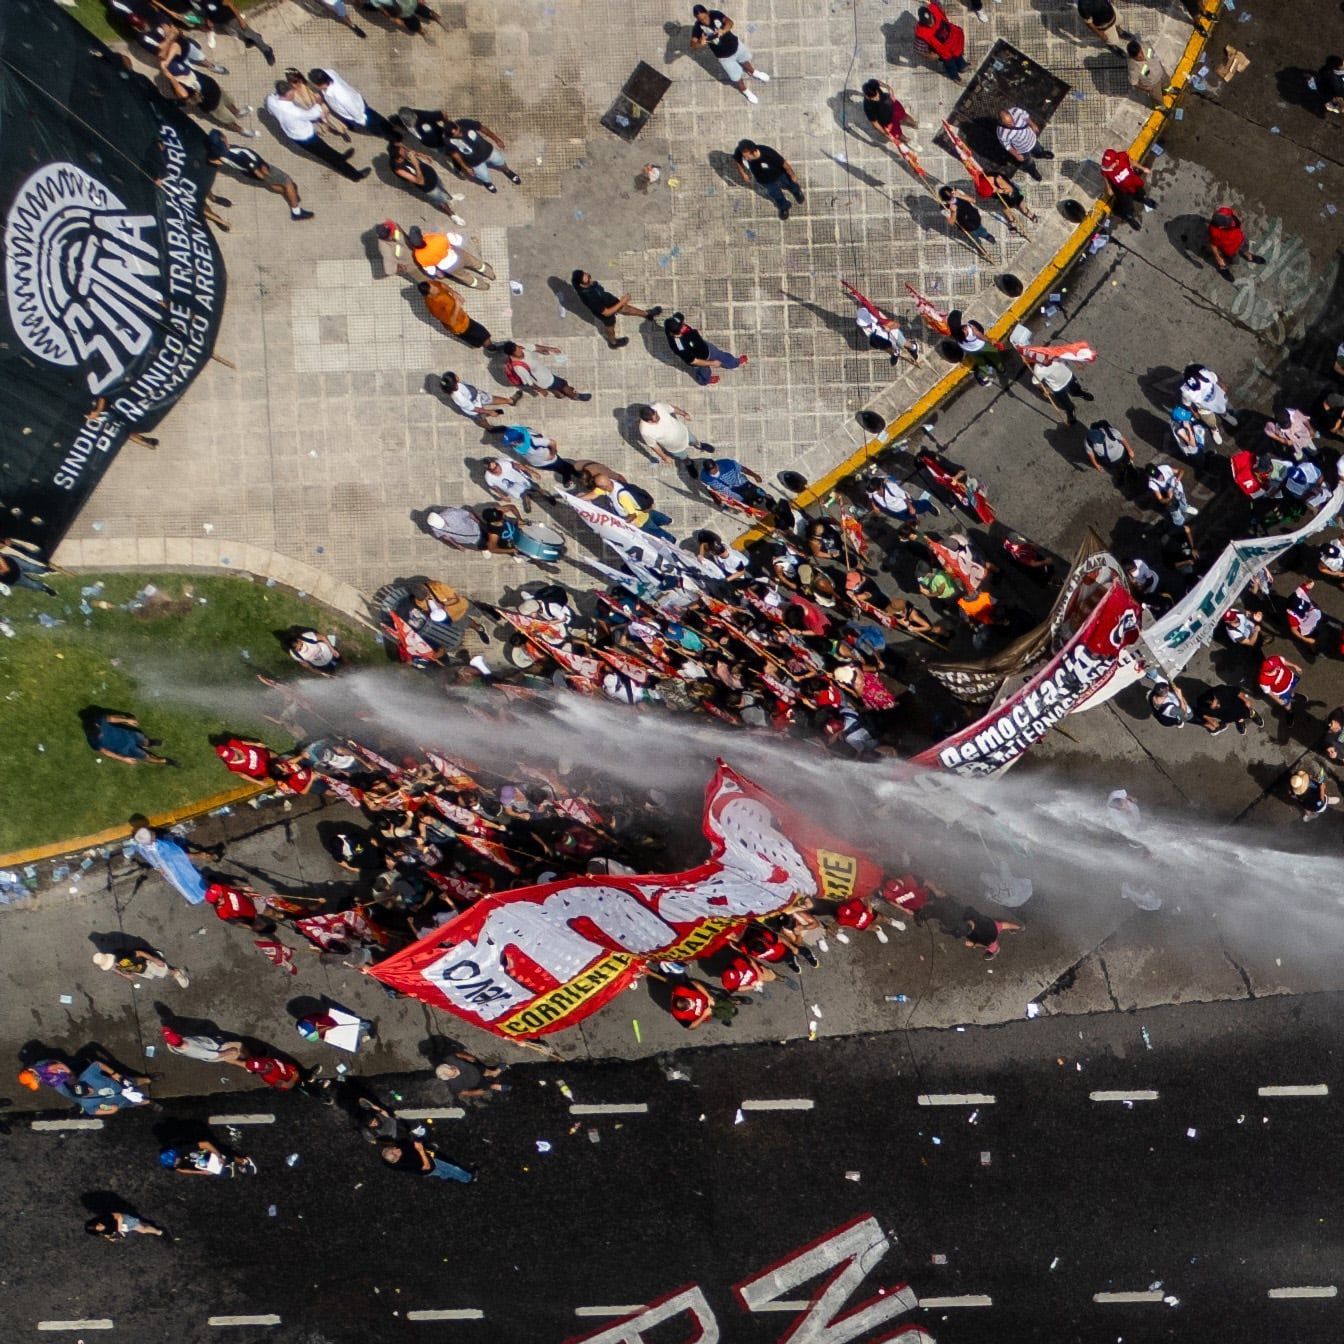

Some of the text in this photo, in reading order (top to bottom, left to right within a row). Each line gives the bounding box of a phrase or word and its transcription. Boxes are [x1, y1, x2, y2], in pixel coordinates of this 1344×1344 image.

[63, 213, 163, 396] SUTNA
[131, 334, 184, 408] UNICO
[170, 300, 190, 337] DE
[506, 951, 632, 1036] CORRIENTE
